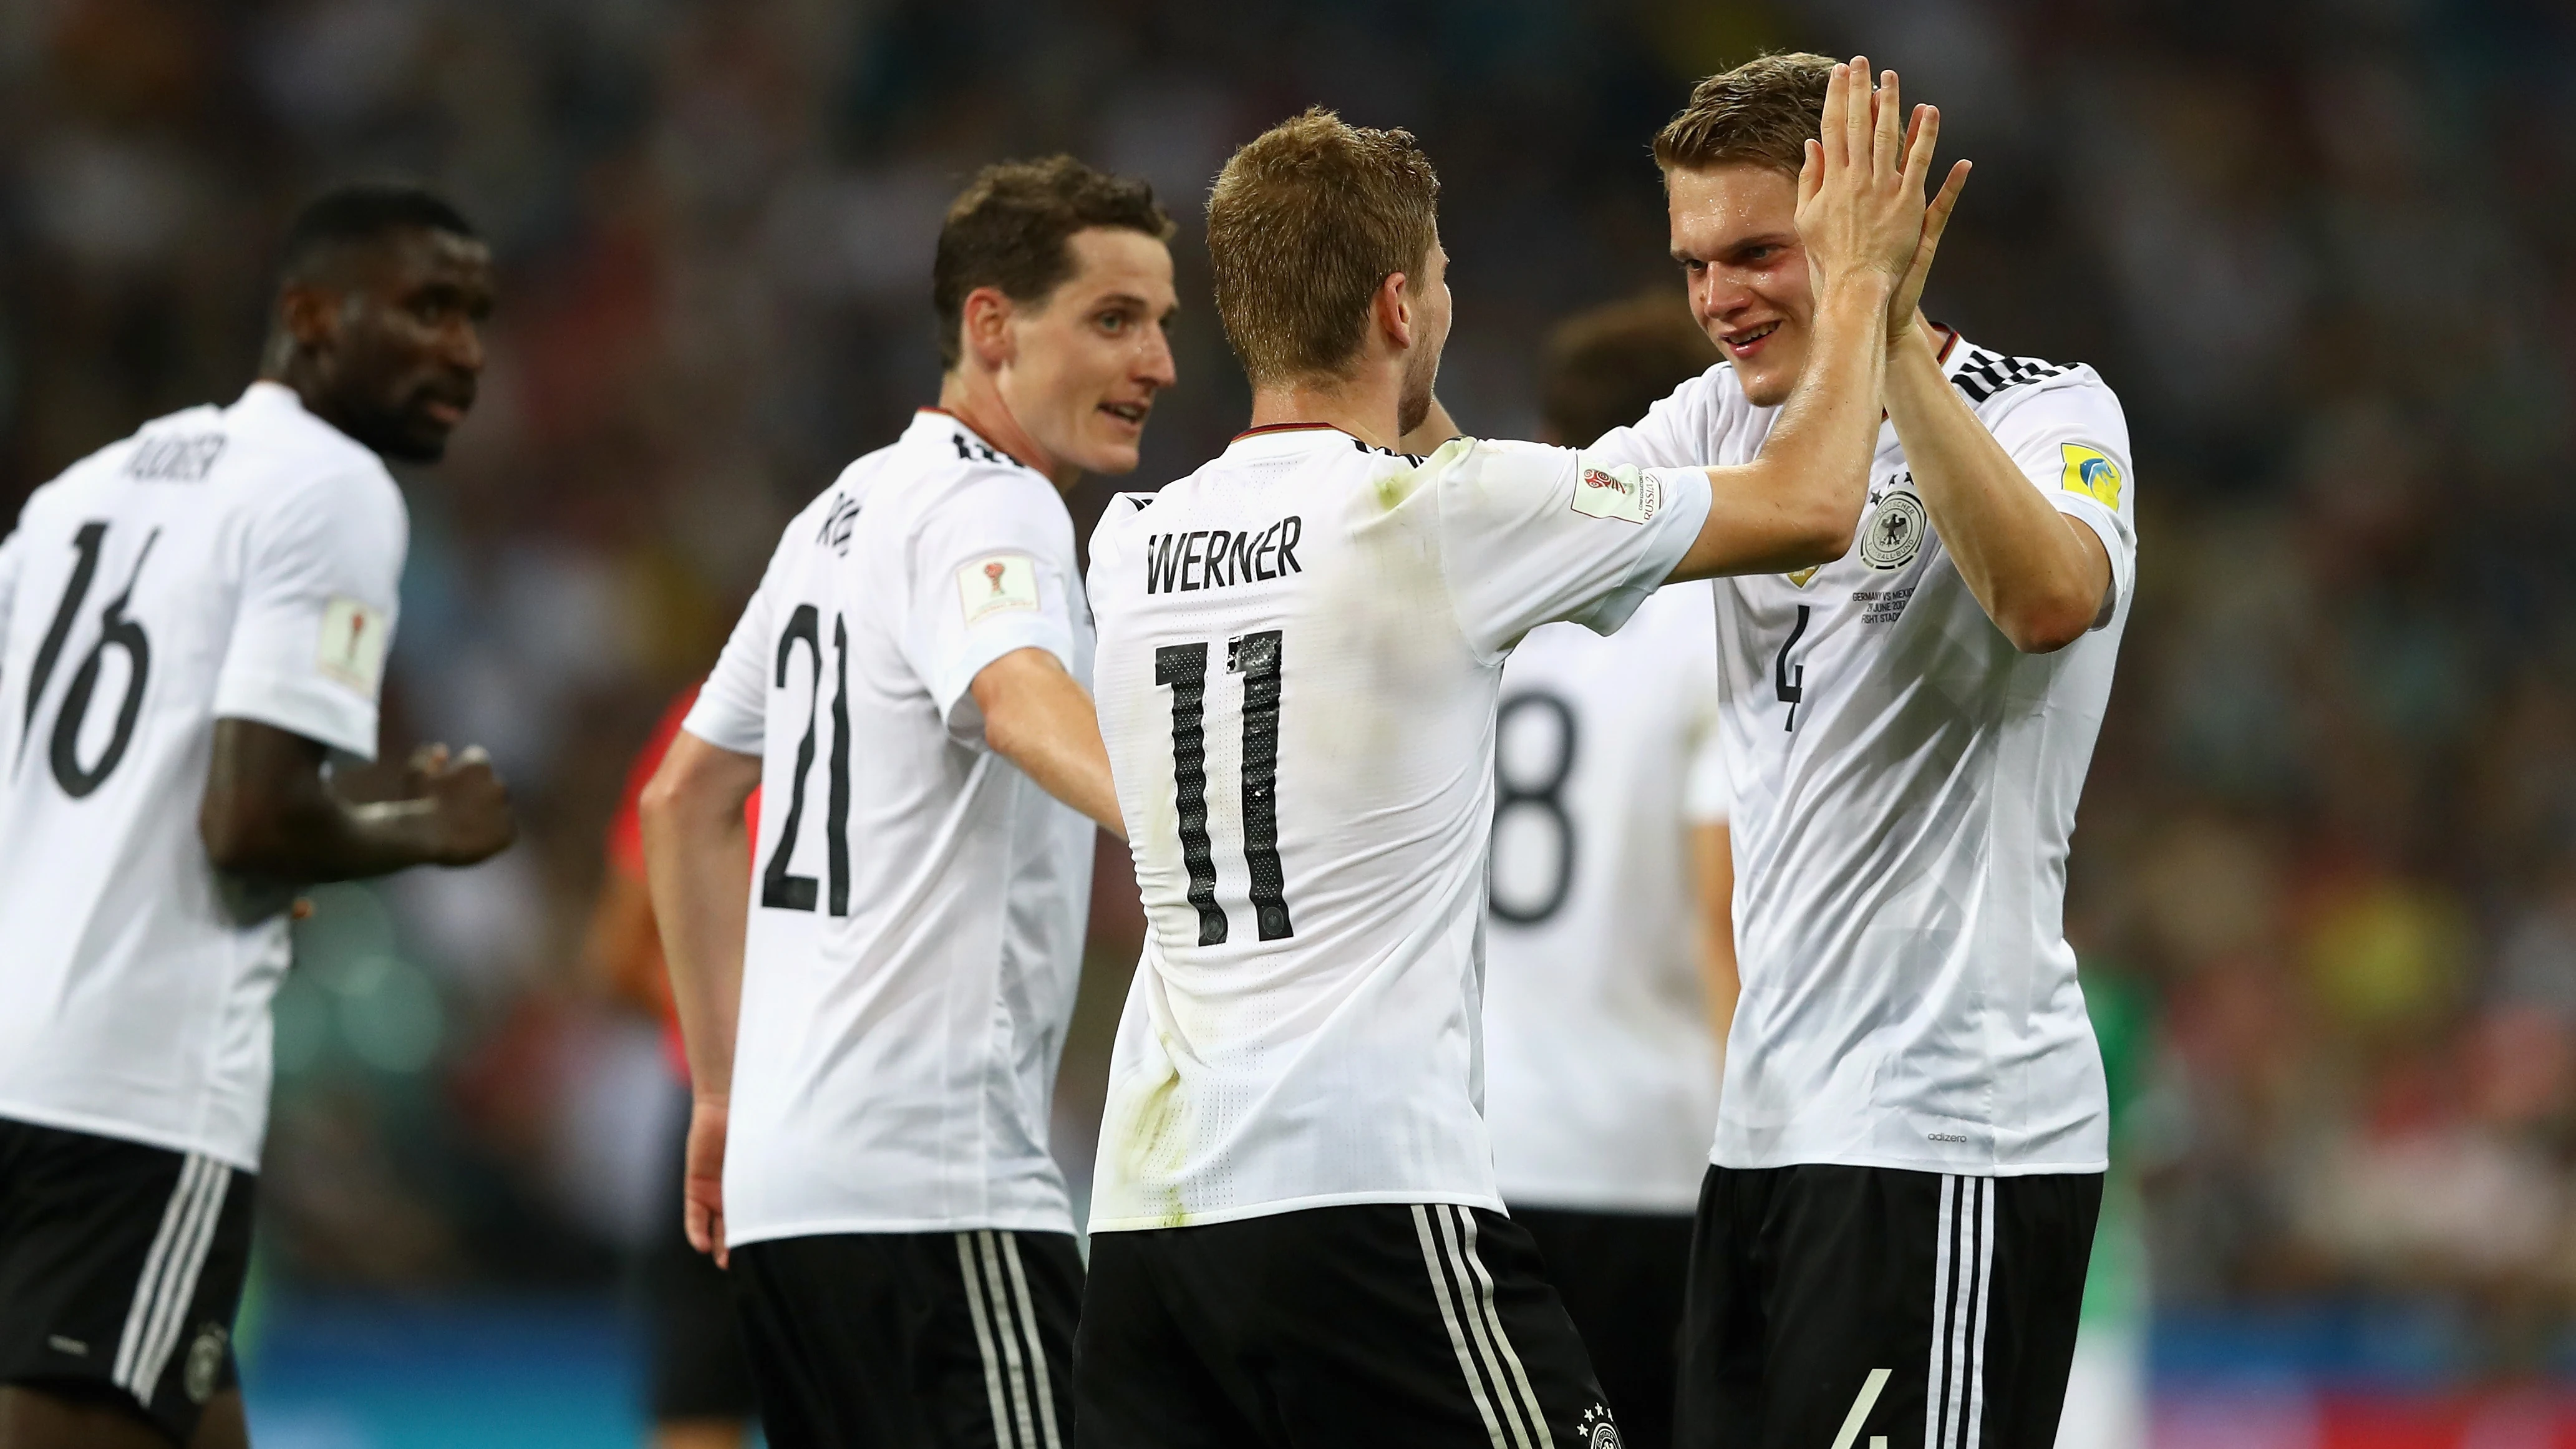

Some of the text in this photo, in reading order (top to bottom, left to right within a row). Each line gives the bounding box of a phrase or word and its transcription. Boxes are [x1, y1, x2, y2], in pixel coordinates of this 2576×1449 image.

[1644, 484, 1654, 520] RUSSIA
[1877, 501, 1915, 518] DEUTSCHER
[1147, 515, 1302, 594] WERNER
[1852, 591, 1882, 602] GERMANY
[1883, 591, 1891, 601] VS
[1873, 603, 1891, 613] JUNE
[12, 522, 162, 800] 16
[1775, 604, 1810, 732] 4
[762, 603, 850, 917] 21
[1155, 629, 1294, 947] 11
[1489, 690, 1578, 927] 8
[1927, 1132, 1967, 1143] adizero
